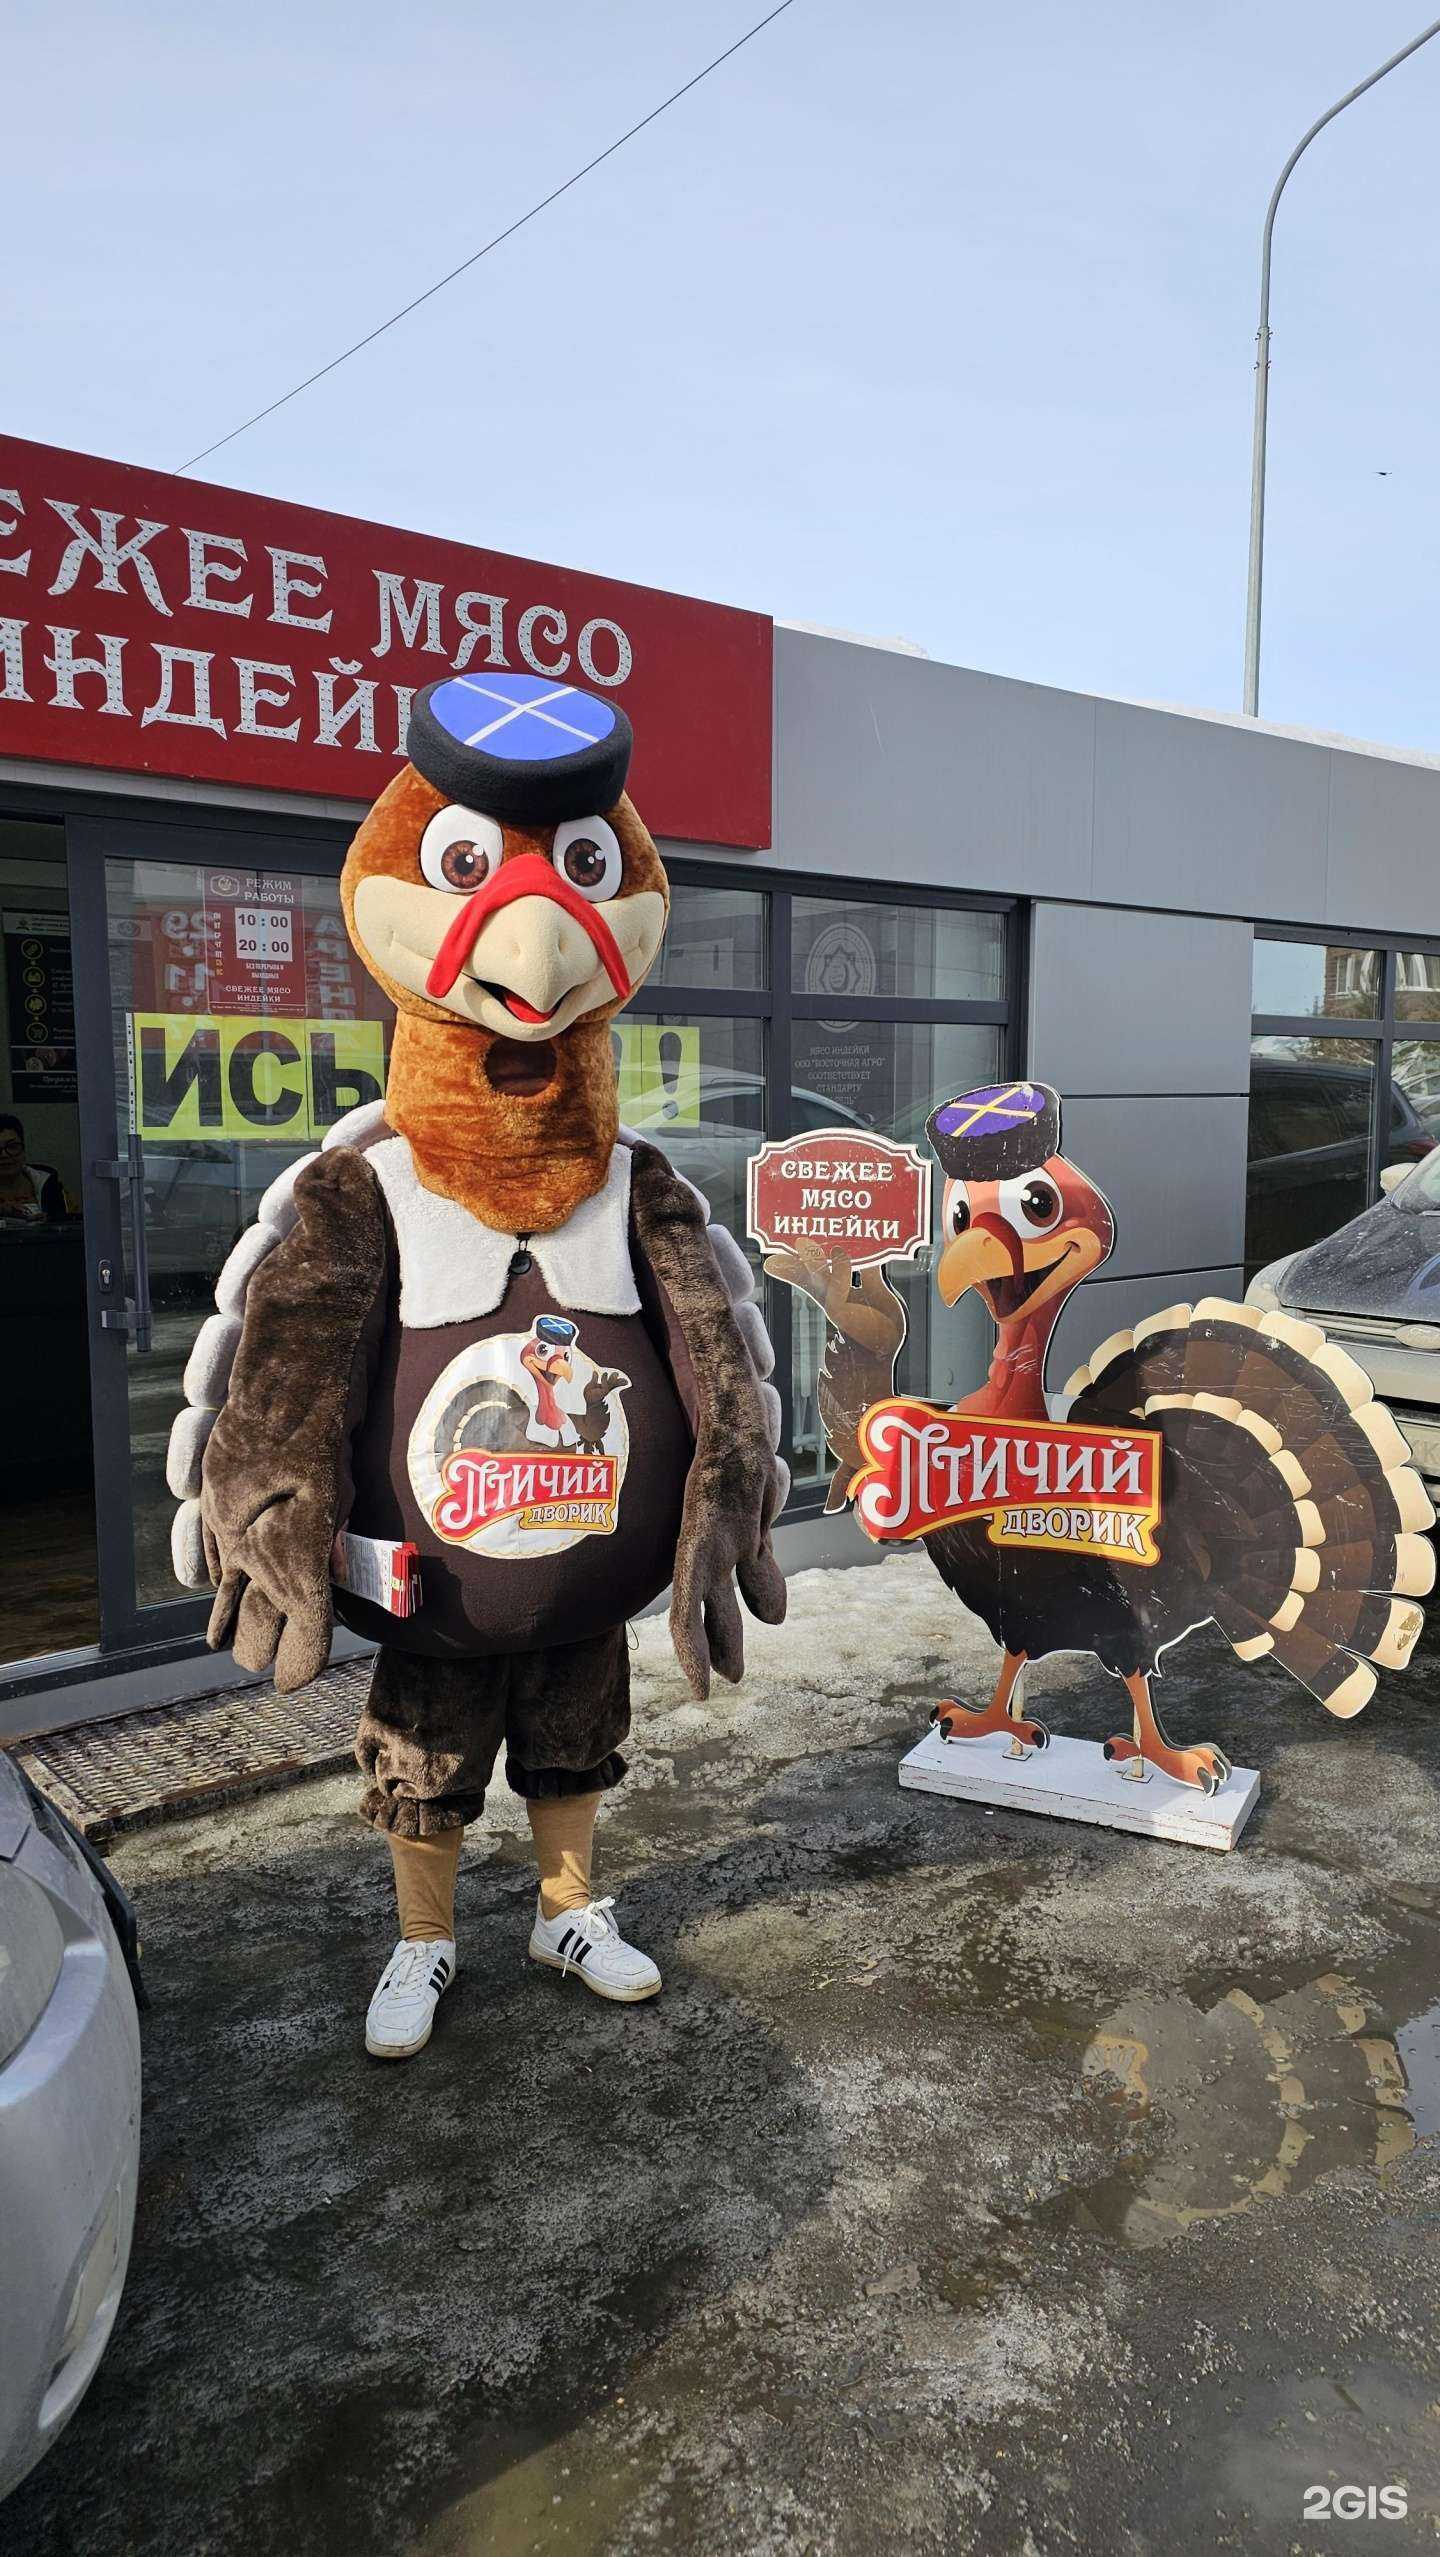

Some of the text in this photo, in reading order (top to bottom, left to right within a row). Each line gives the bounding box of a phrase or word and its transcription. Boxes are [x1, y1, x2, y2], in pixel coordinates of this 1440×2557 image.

[370, 569, 633, 686] МЯСО
[246, 878, 292, 891] РЕЖИМ
[244, 892, 294, 904] РАБОТЫ
[225, 984, 291, 994] СВЕЖЕЕ МЯСО
[237, 994, 281, 1003] ИНДЕЙКИ
[781, 1160, 893, 1183] СВЕЖЕЕ
[801, 1188, 872, 1210] МЯСО
[774, 1214, 900, 1241] ИНДЕЙКИ
[529, 1503, 608, 1526] ДВОРИК
[1001, 1507, 1147, 1556] ДВОРИК
